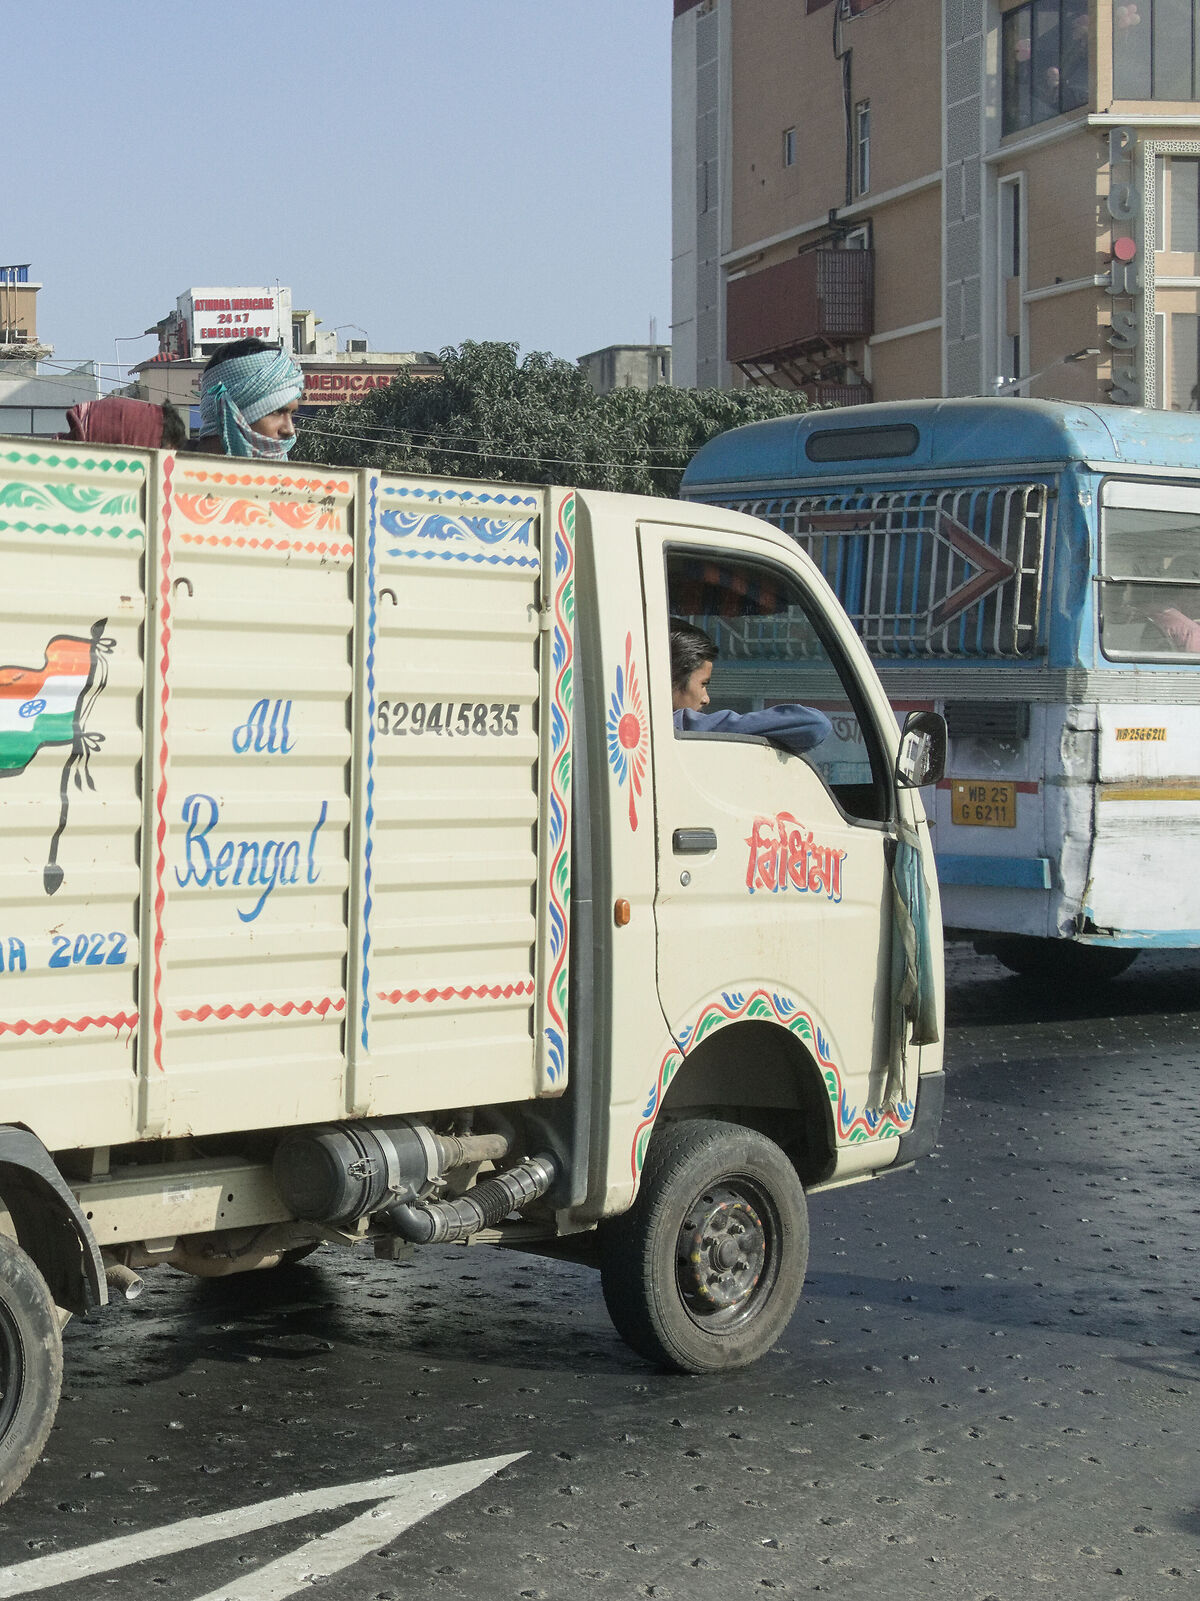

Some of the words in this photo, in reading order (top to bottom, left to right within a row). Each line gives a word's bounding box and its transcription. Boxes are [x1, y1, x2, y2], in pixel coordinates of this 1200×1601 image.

[231, 298, 274, 310] MEDICARE
[201, 327, 270, 339] EMERGENCY
[309, 392, 348, 402] NURSING
[232, 698, 299, 755] All
[969, 787, 986, 801] WB
[991, 787, 1008, 803] 25
[962, 804, 970, 819] G
[976, 804, 1006, 822] 6211
[174, 793, 329, 923] Bengal
[48, 931, 128, 969] 2022
